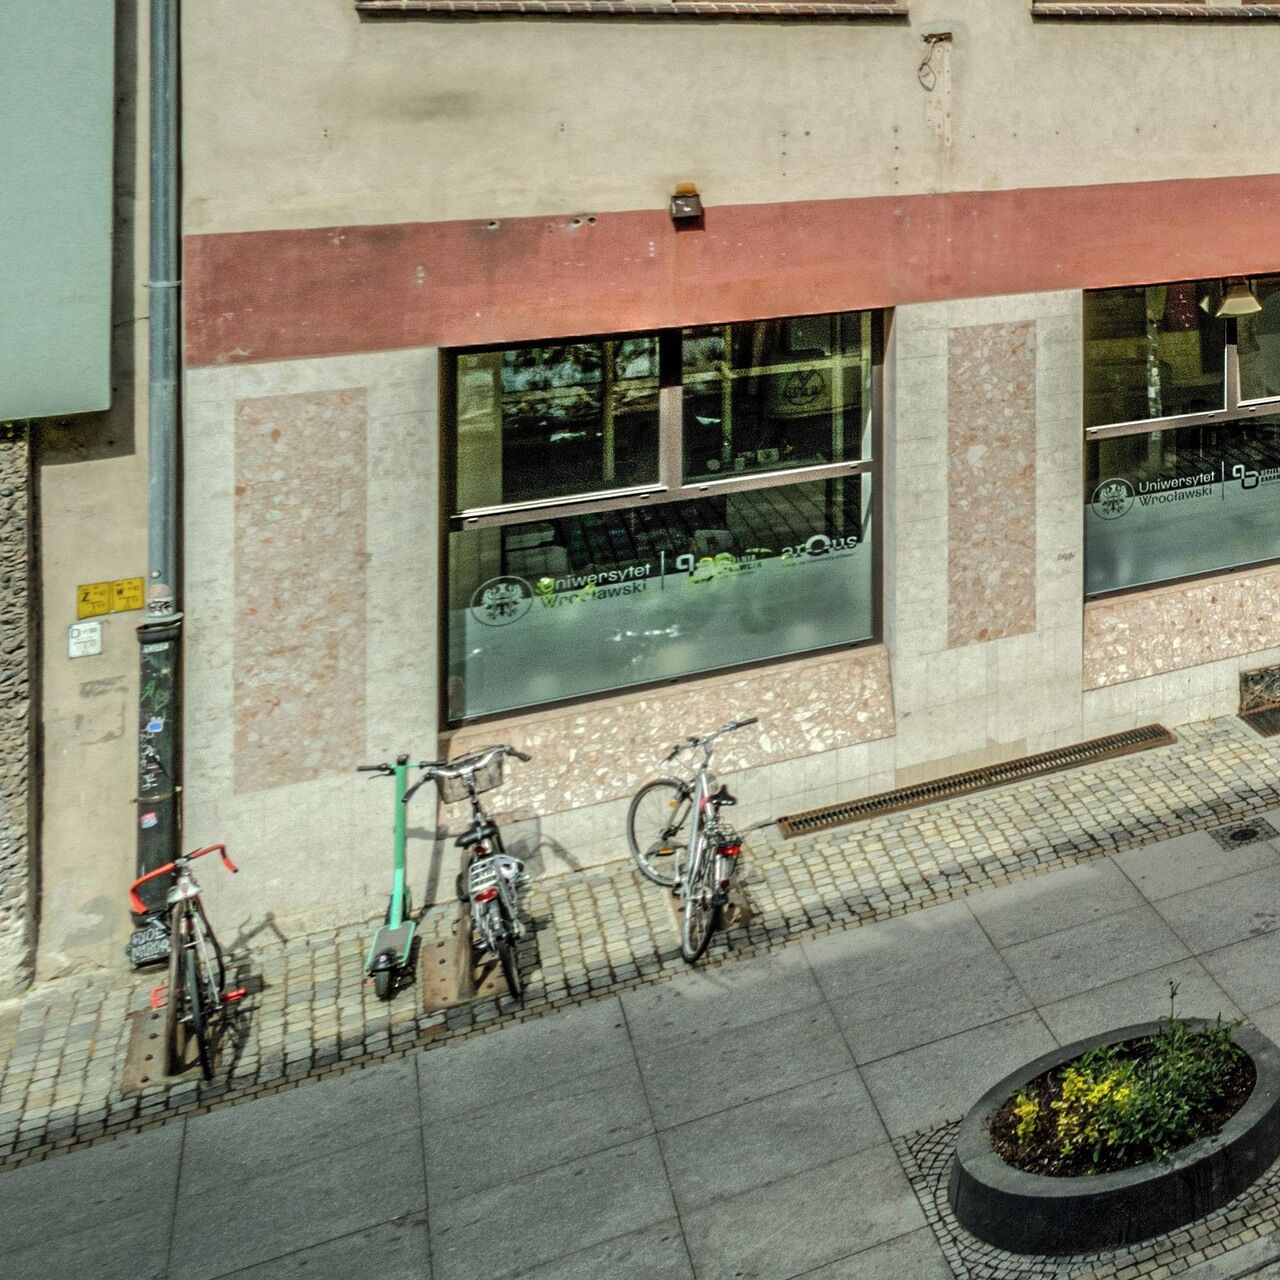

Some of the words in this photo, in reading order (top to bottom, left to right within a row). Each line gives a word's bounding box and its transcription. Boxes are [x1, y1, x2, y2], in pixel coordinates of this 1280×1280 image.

[1139, 471, 1215, 493] Uniwersytet
[1140, 486, 1213, 507] Wrocławski
[81, 592, 91, 602] Z
